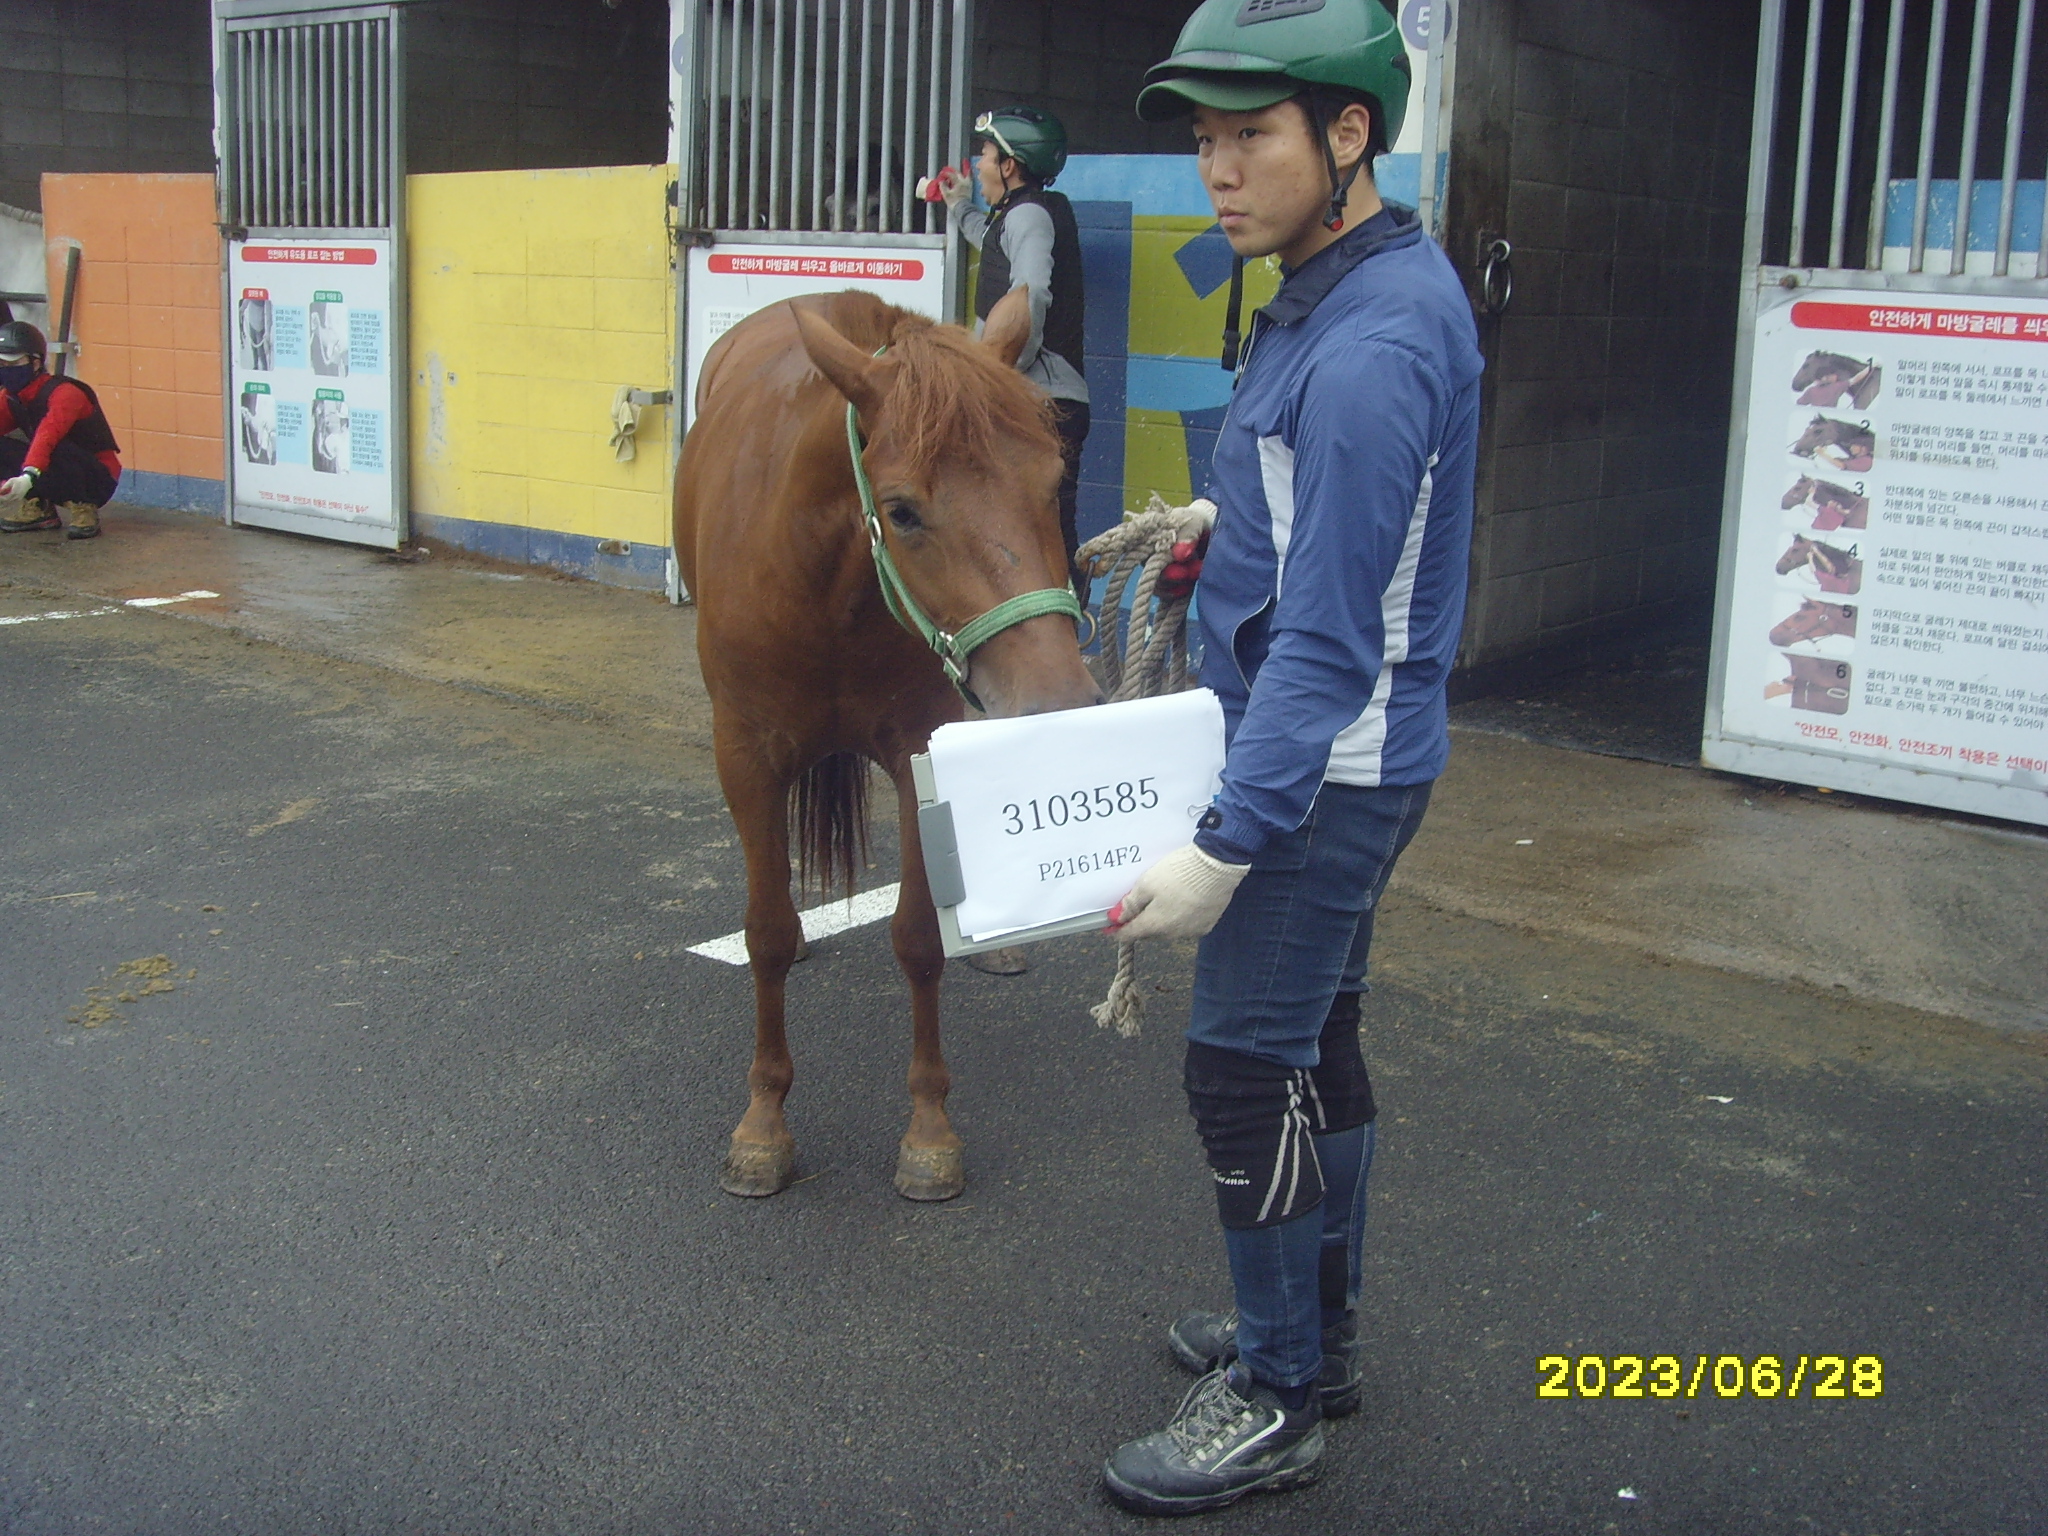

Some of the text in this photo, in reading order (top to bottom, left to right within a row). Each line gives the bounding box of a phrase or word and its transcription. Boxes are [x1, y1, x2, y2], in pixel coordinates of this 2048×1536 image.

[732, 258, 902, 275] 안전하게 마방굴레 씌우고 올바르게 이동하기
[1870, 310, 1932, 329] 안전하게
[1937, 314, 2018, 335] 마방굴레를
[1896, 373, 1926, 385] 이렇게
[1930, 376, 1949, 387] 하여
[1854, 481, 1864, 496] 3
[1928, 488, 1948, 500] 있는
[1848, 544, 1857, 557] 4
[1973, 557, 1992, 569] 있는
[1843, 605, 1853, 618] 5
[1836, 664, 1847, 679] 6
[1899, 738, 1952, 759] 안전조끼
[1959, 747, 2000, 766] 착용은
[1002, 777, 1158, 835] 3103585
[1038, 845, 1141, 881] P21614F2
